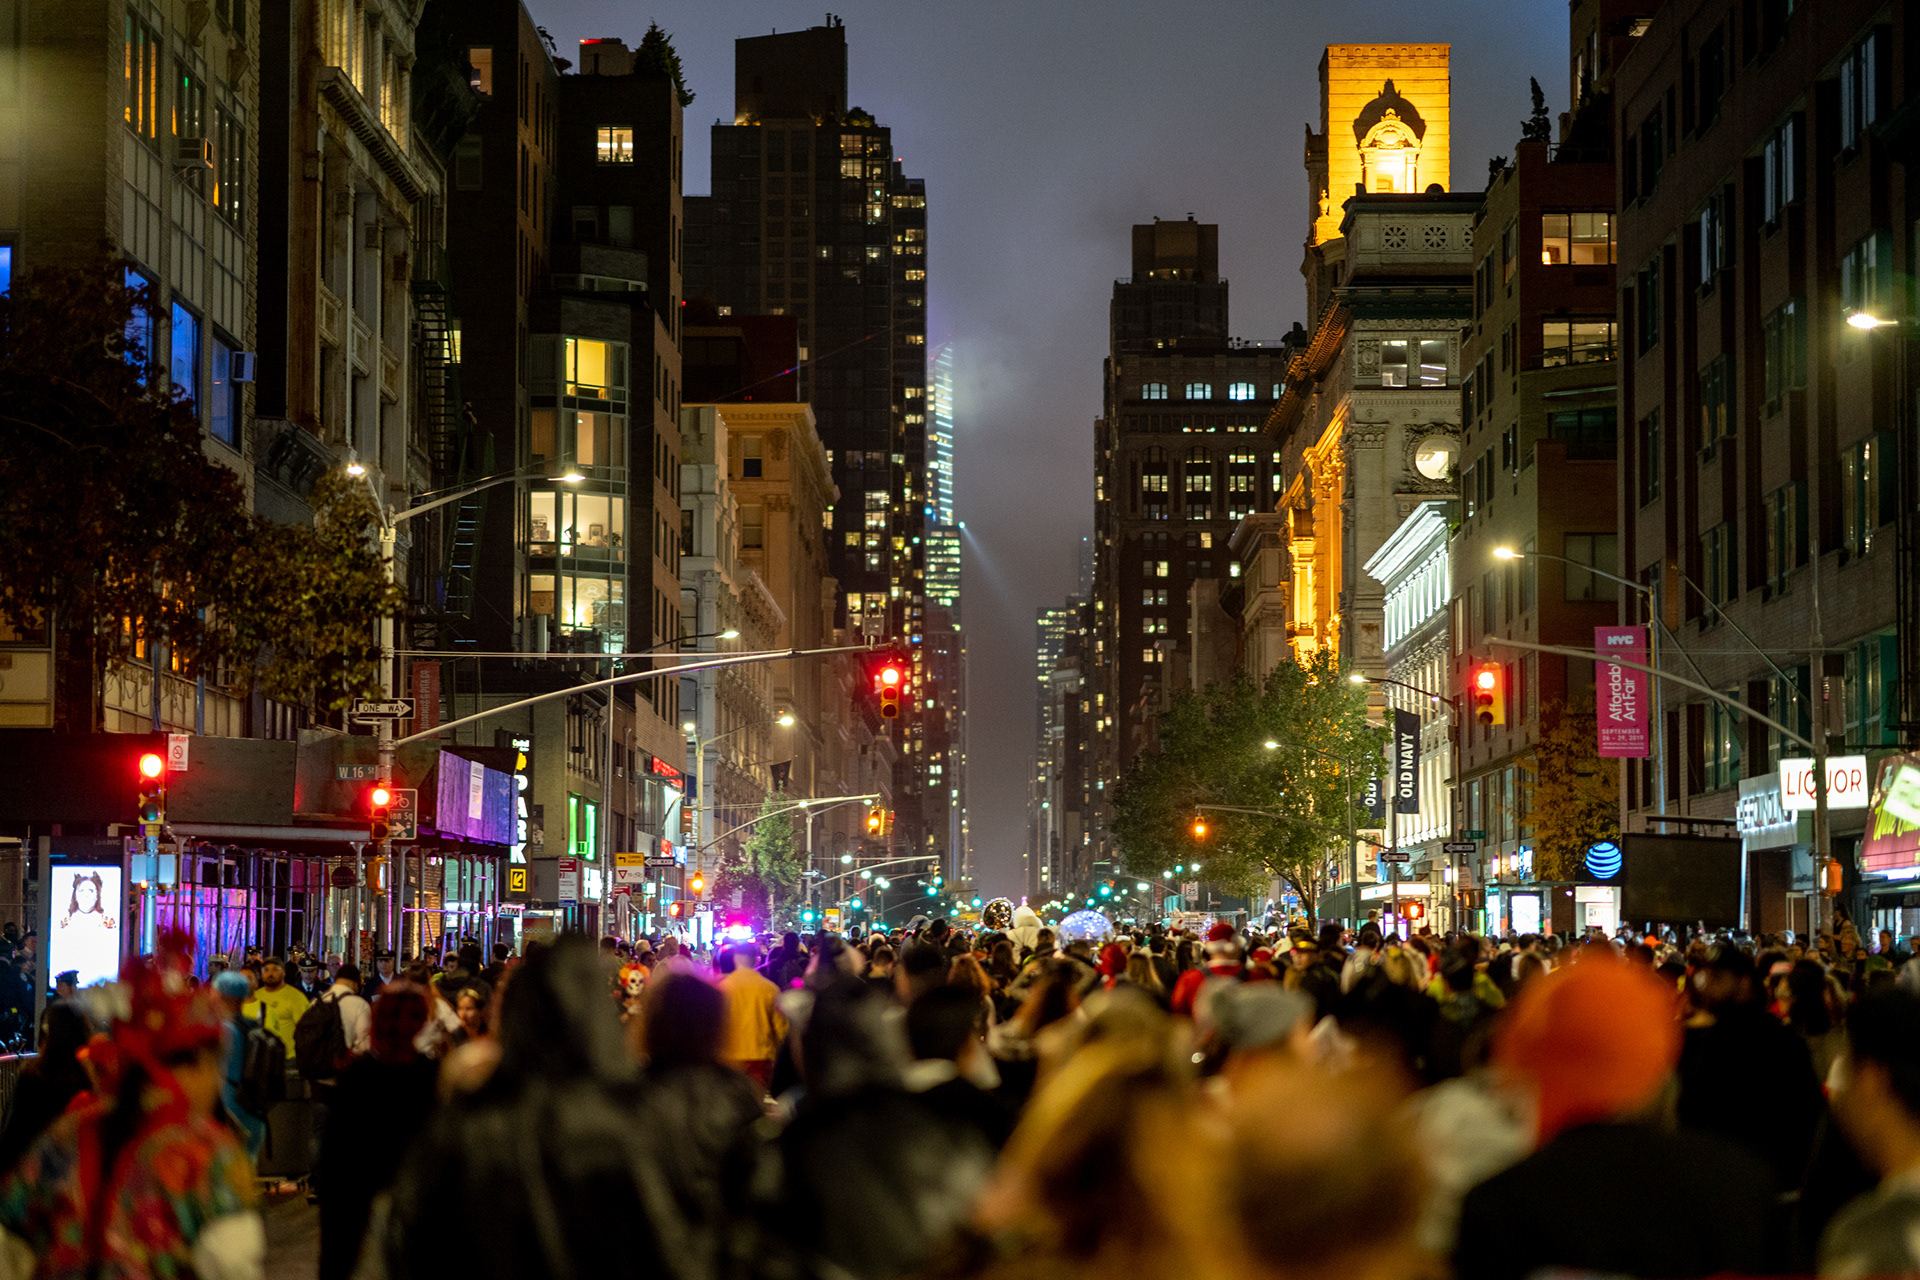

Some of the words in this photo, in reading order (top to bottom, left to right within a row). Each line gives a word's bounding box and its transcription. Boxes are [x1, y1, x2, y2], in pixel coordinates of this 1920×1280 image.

[1607, 635, 1634, 645] NYC
[420, 680, 430, 693] PITA
[1622, 678, 1636, 700] Fair
[363, 704, 380, 713] ONE
[388, 704, 406, 713] WAY
[420, 700, 430, 730] HUMMUS
[1622, 701, 1636, 722] Art
[1401, 733, 1414, 770] NAVY
[339, 767, 349, 778] W
[353, 767, 364, 778] 16
[1364, 782, 1377, 807] OLD
[1400, 772, 1413, 798] OLD
[404, 812, 414, 822] Sq
[510, 774, 529, 864] PARK
